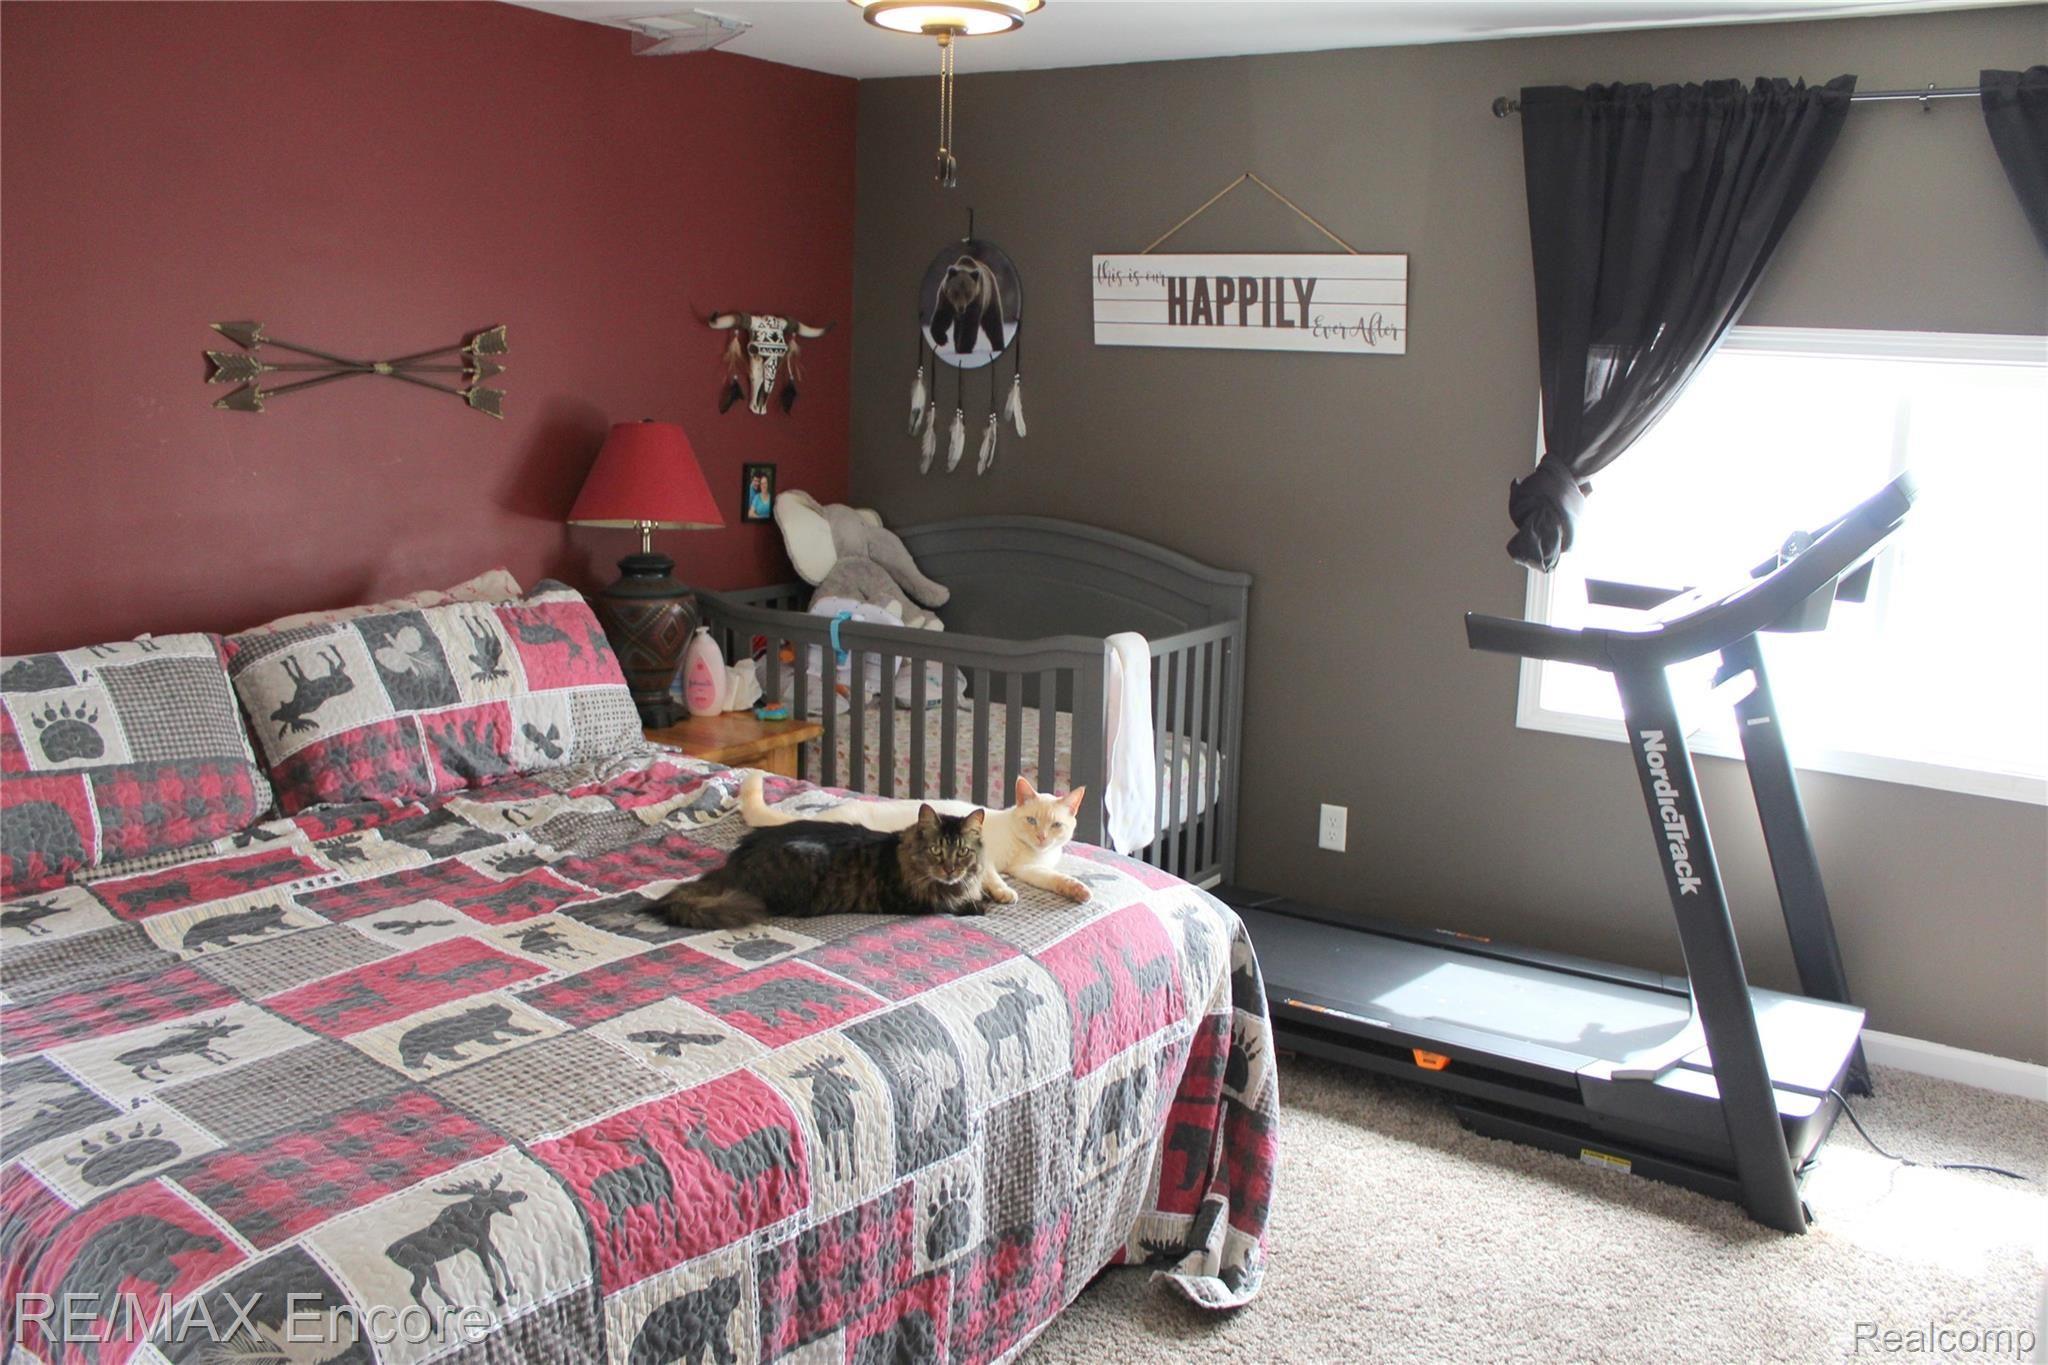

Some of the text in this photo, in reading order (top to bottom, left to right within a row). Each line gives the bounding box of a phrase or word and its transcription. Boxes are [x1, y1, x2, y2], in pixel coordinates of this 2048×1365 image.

[1097, 260, 1122, 287] this
[1128, 268, 1140, 287] is
[1167, 276, 1317, 329] HAPPILY
[1312, 311, 1398, 347] Ever After
[1640, 730, 1702, 895] NordicTrack
